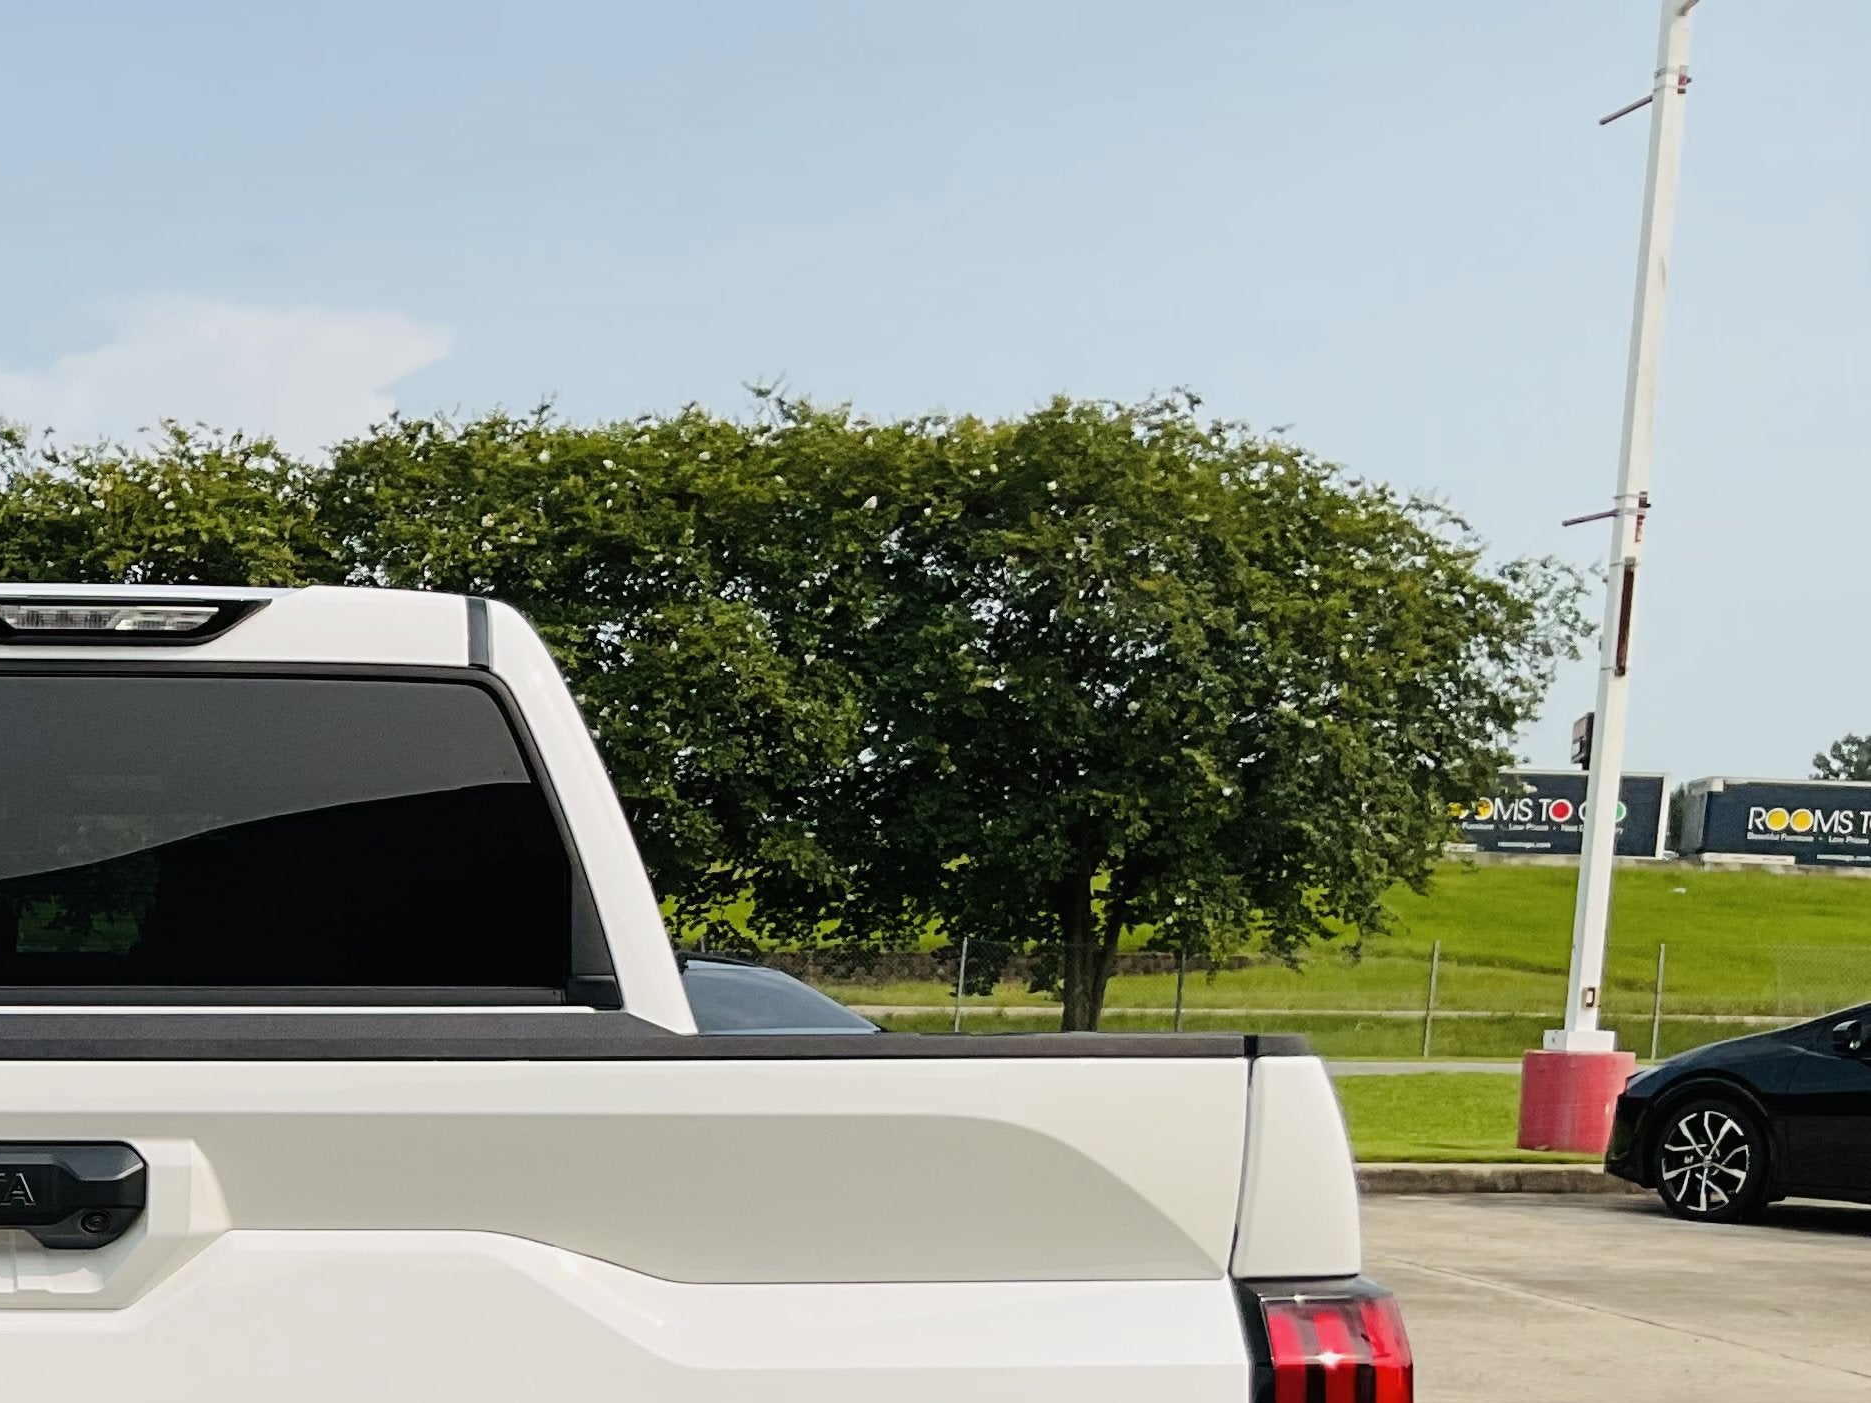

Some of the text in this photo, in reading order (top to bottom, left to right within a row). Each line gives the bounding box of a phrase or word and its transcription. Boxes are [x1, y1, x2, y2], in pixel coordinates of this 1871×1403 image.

[1448, 797, 1534, 822] OOMS
[1539, 798, 1574, 823] TO
[1747, 806, 1871, 835] ROOMS T
